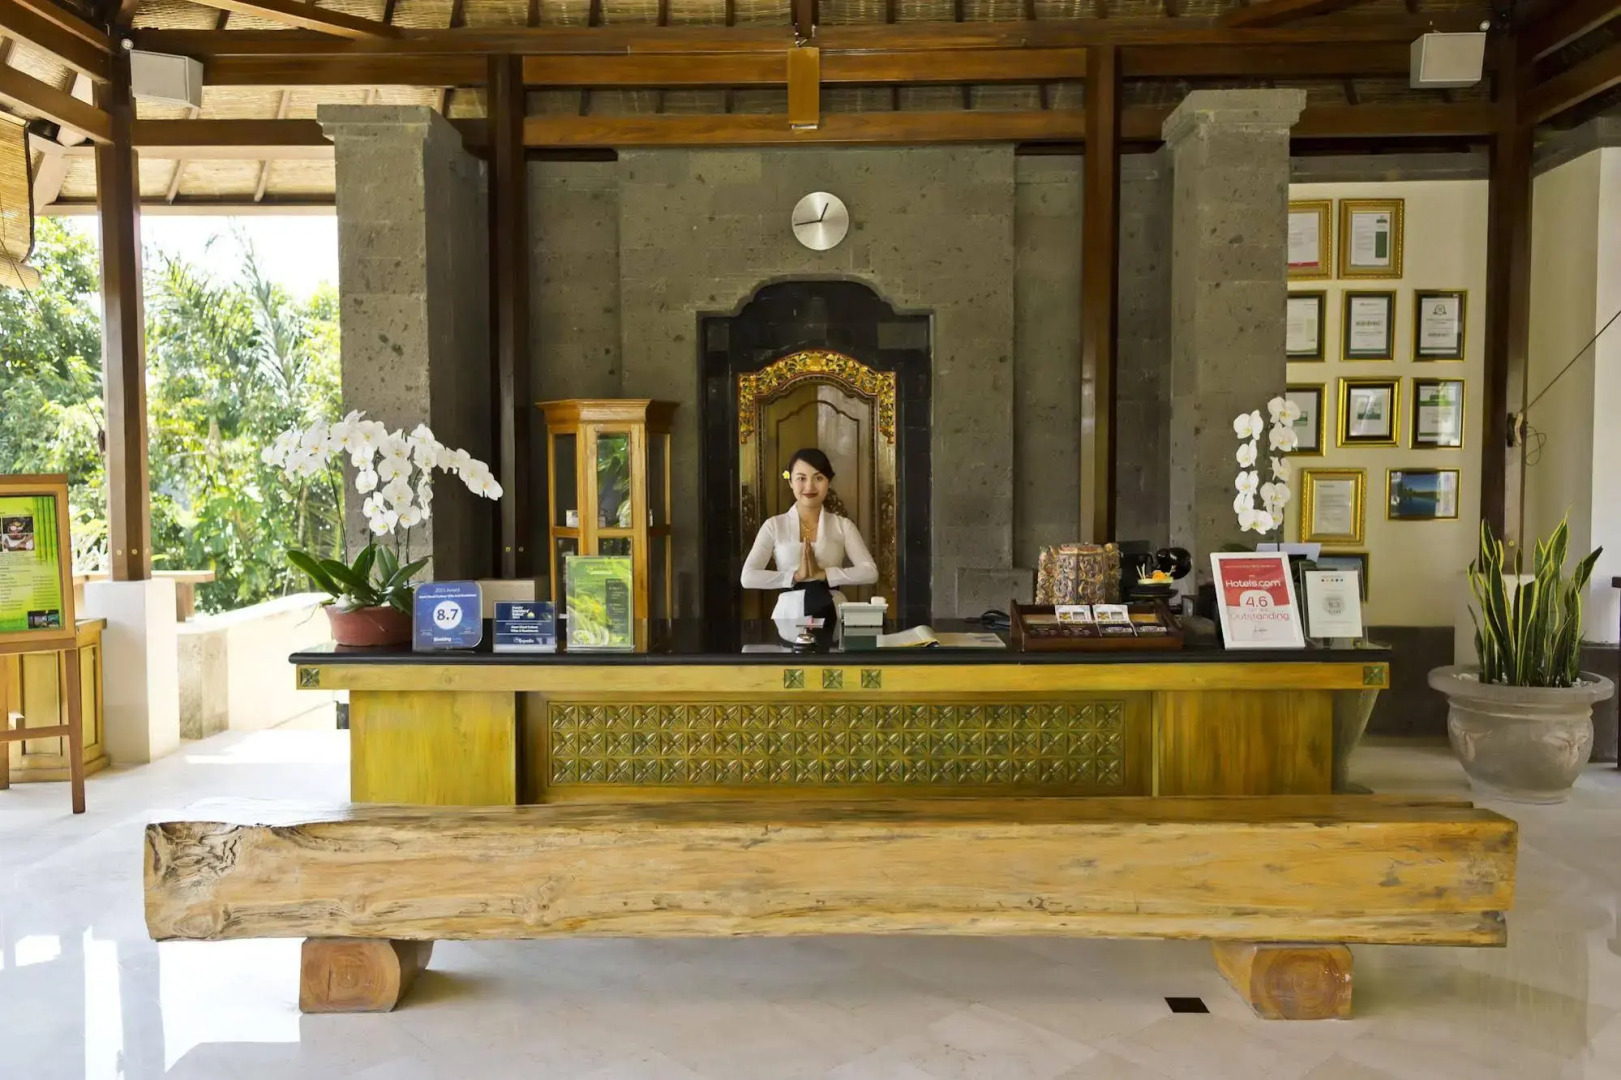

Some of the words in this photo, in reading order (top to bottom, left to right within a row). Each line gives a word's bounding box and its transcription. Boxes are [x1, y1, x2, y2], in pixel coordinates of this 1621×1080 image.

[1225, 579, 1281, 588] Hotels.com
[1245, 595, 1268, 608] 4.6
[436, 608, 459, 621] 8.7
[1230, 611, 1290, 621] Outstanding
